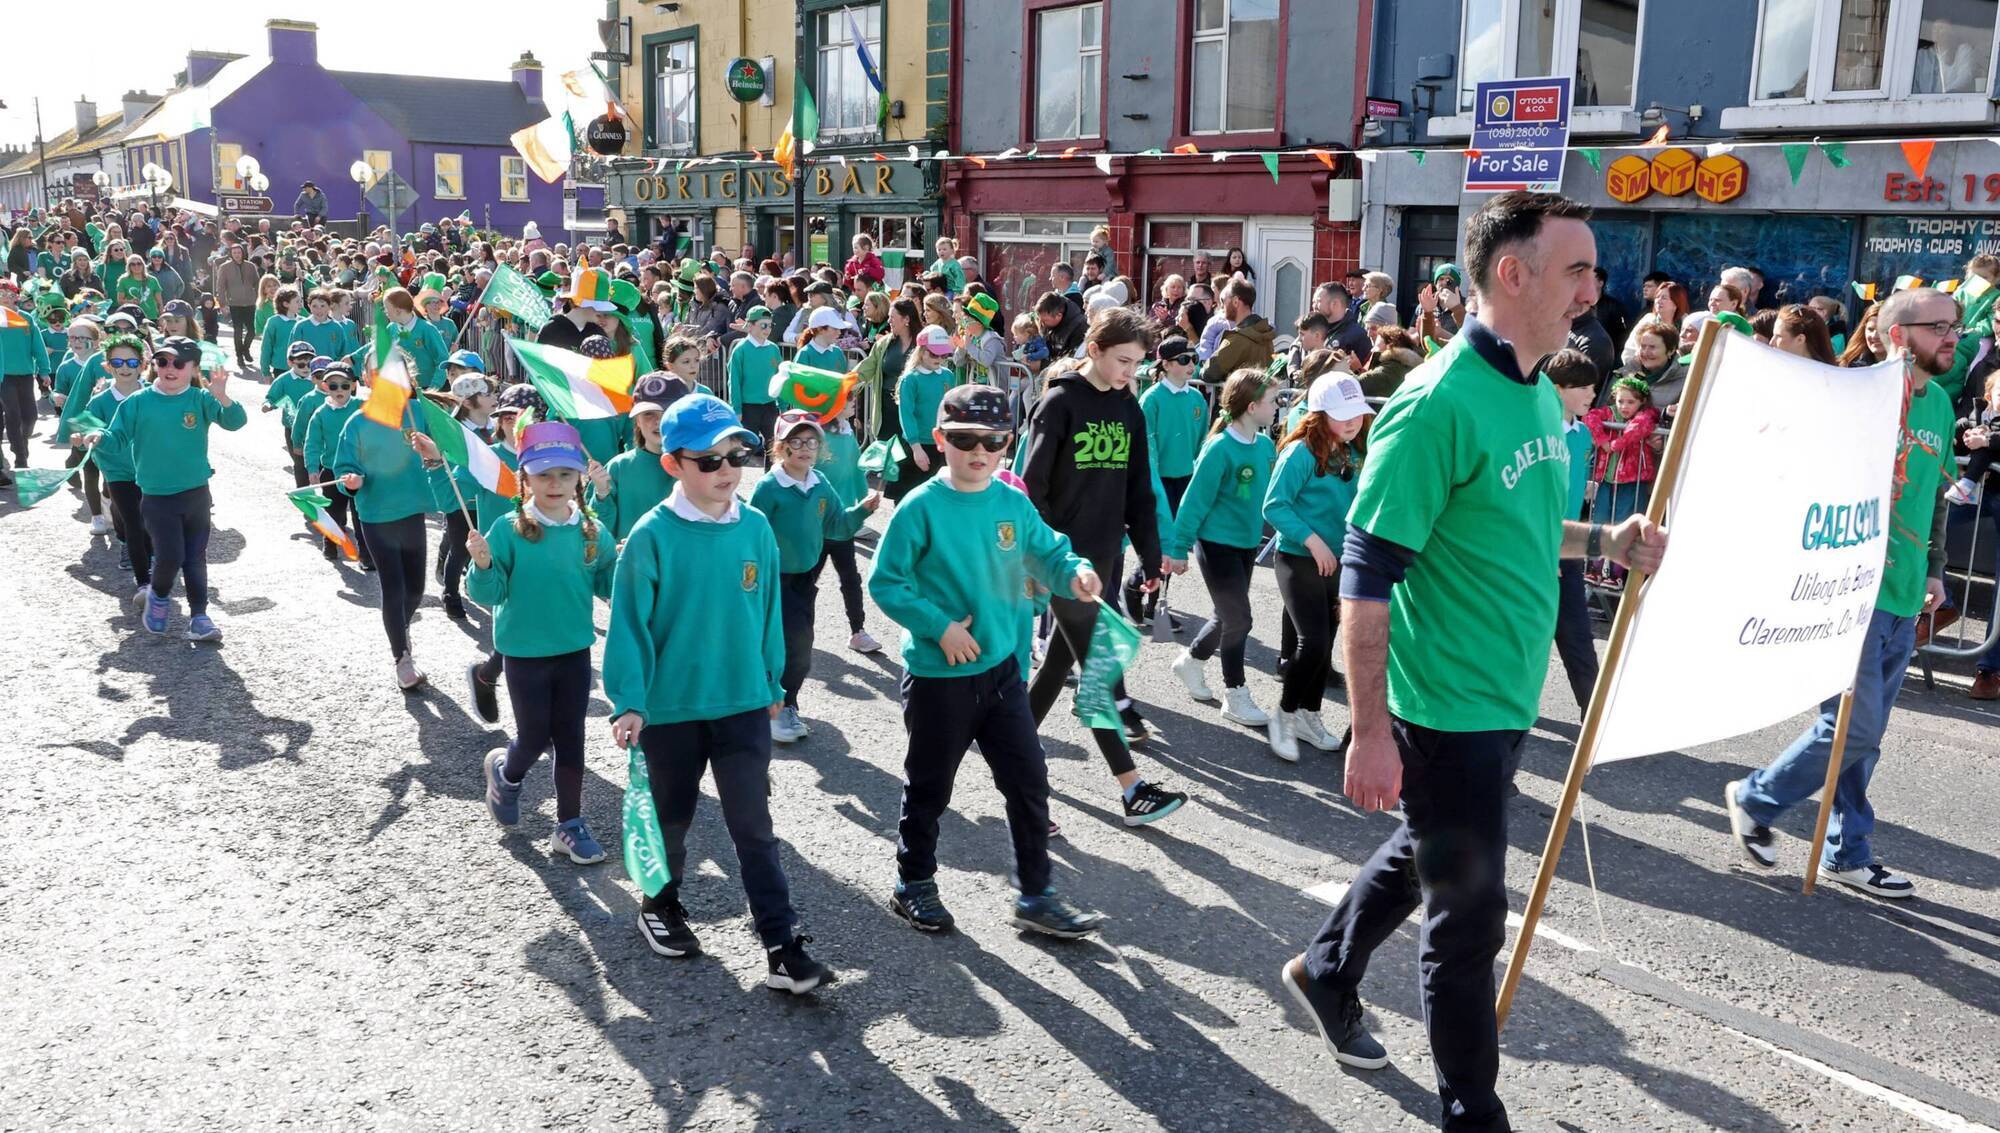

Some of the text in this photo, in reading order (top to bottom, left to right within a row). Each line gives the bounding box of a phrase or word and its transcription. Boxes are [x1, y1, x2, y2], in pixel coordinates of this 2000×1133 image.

[593, 130, 623, 141] GUINNESS
[1488, 126, 1549, 140] (098) 28000
[1479, 154, 1549, 173] For Sale
[815, 164, 895, 196] BAR
[1609, 165, 1738, 198] SMYTHS
[1884, 172, 1945, 202] Est:
[1907, 219, 1978, 235] TROPHY
